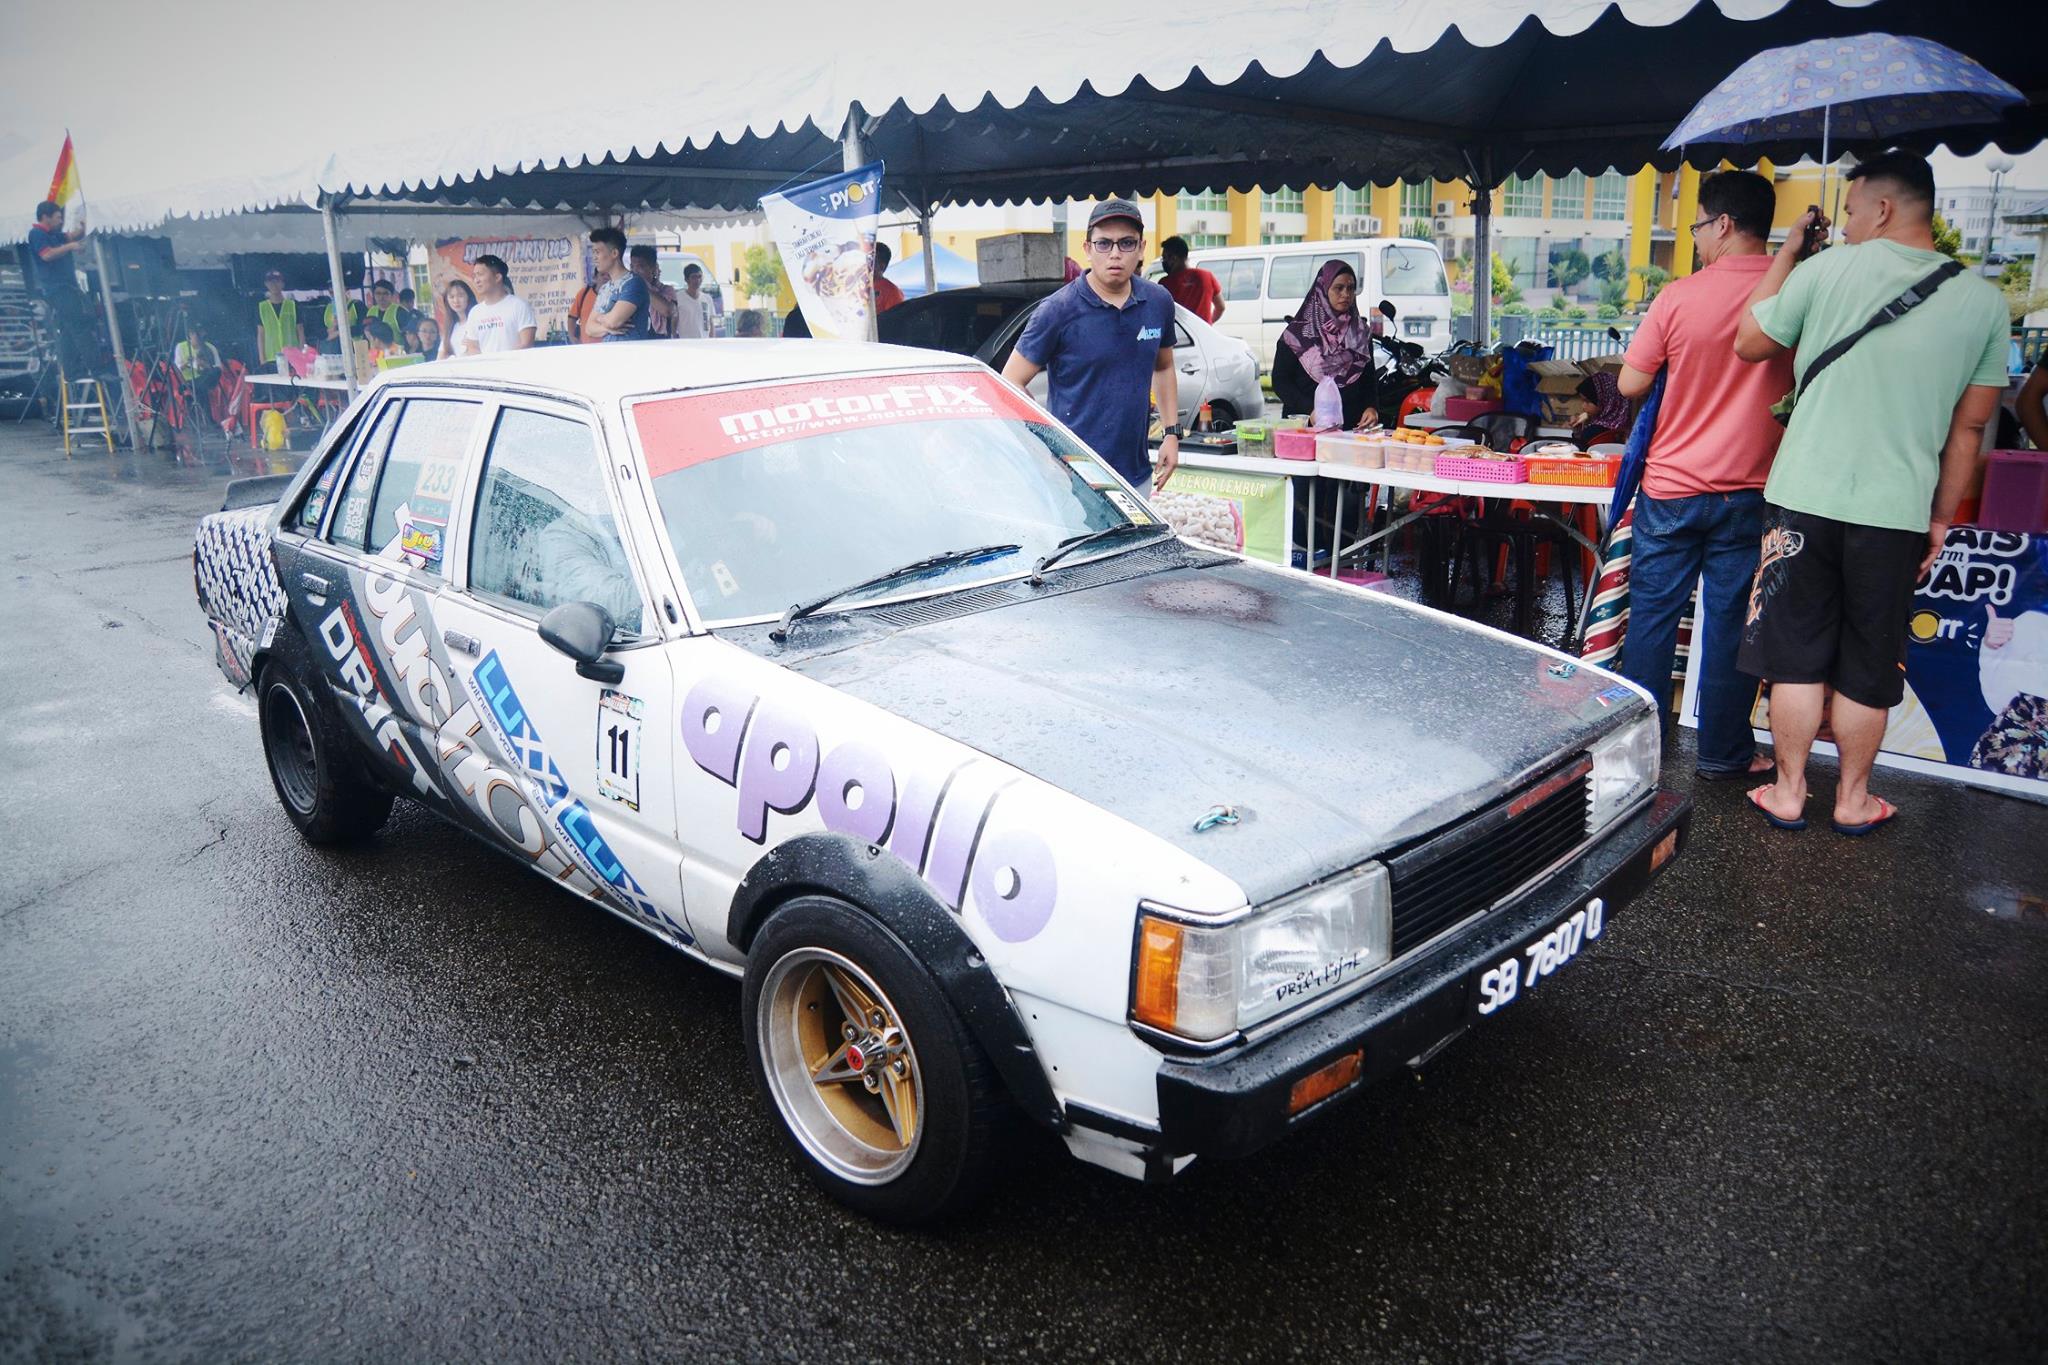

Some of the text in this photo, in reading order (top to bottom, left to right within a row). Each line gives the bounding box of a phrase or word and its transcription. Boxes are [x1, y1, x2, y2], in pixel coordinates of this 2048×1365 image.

[732, 404, 996, 444] http://www.motorfix.com
[1220, 480, 1268, 498] LEMBUT
[607, 723, 630, 780] 11
[681, 674, 1059, 944] apollo
[1478, 957, 1519, 1014] SB
[1525, 910, 1586, 987] 7607
